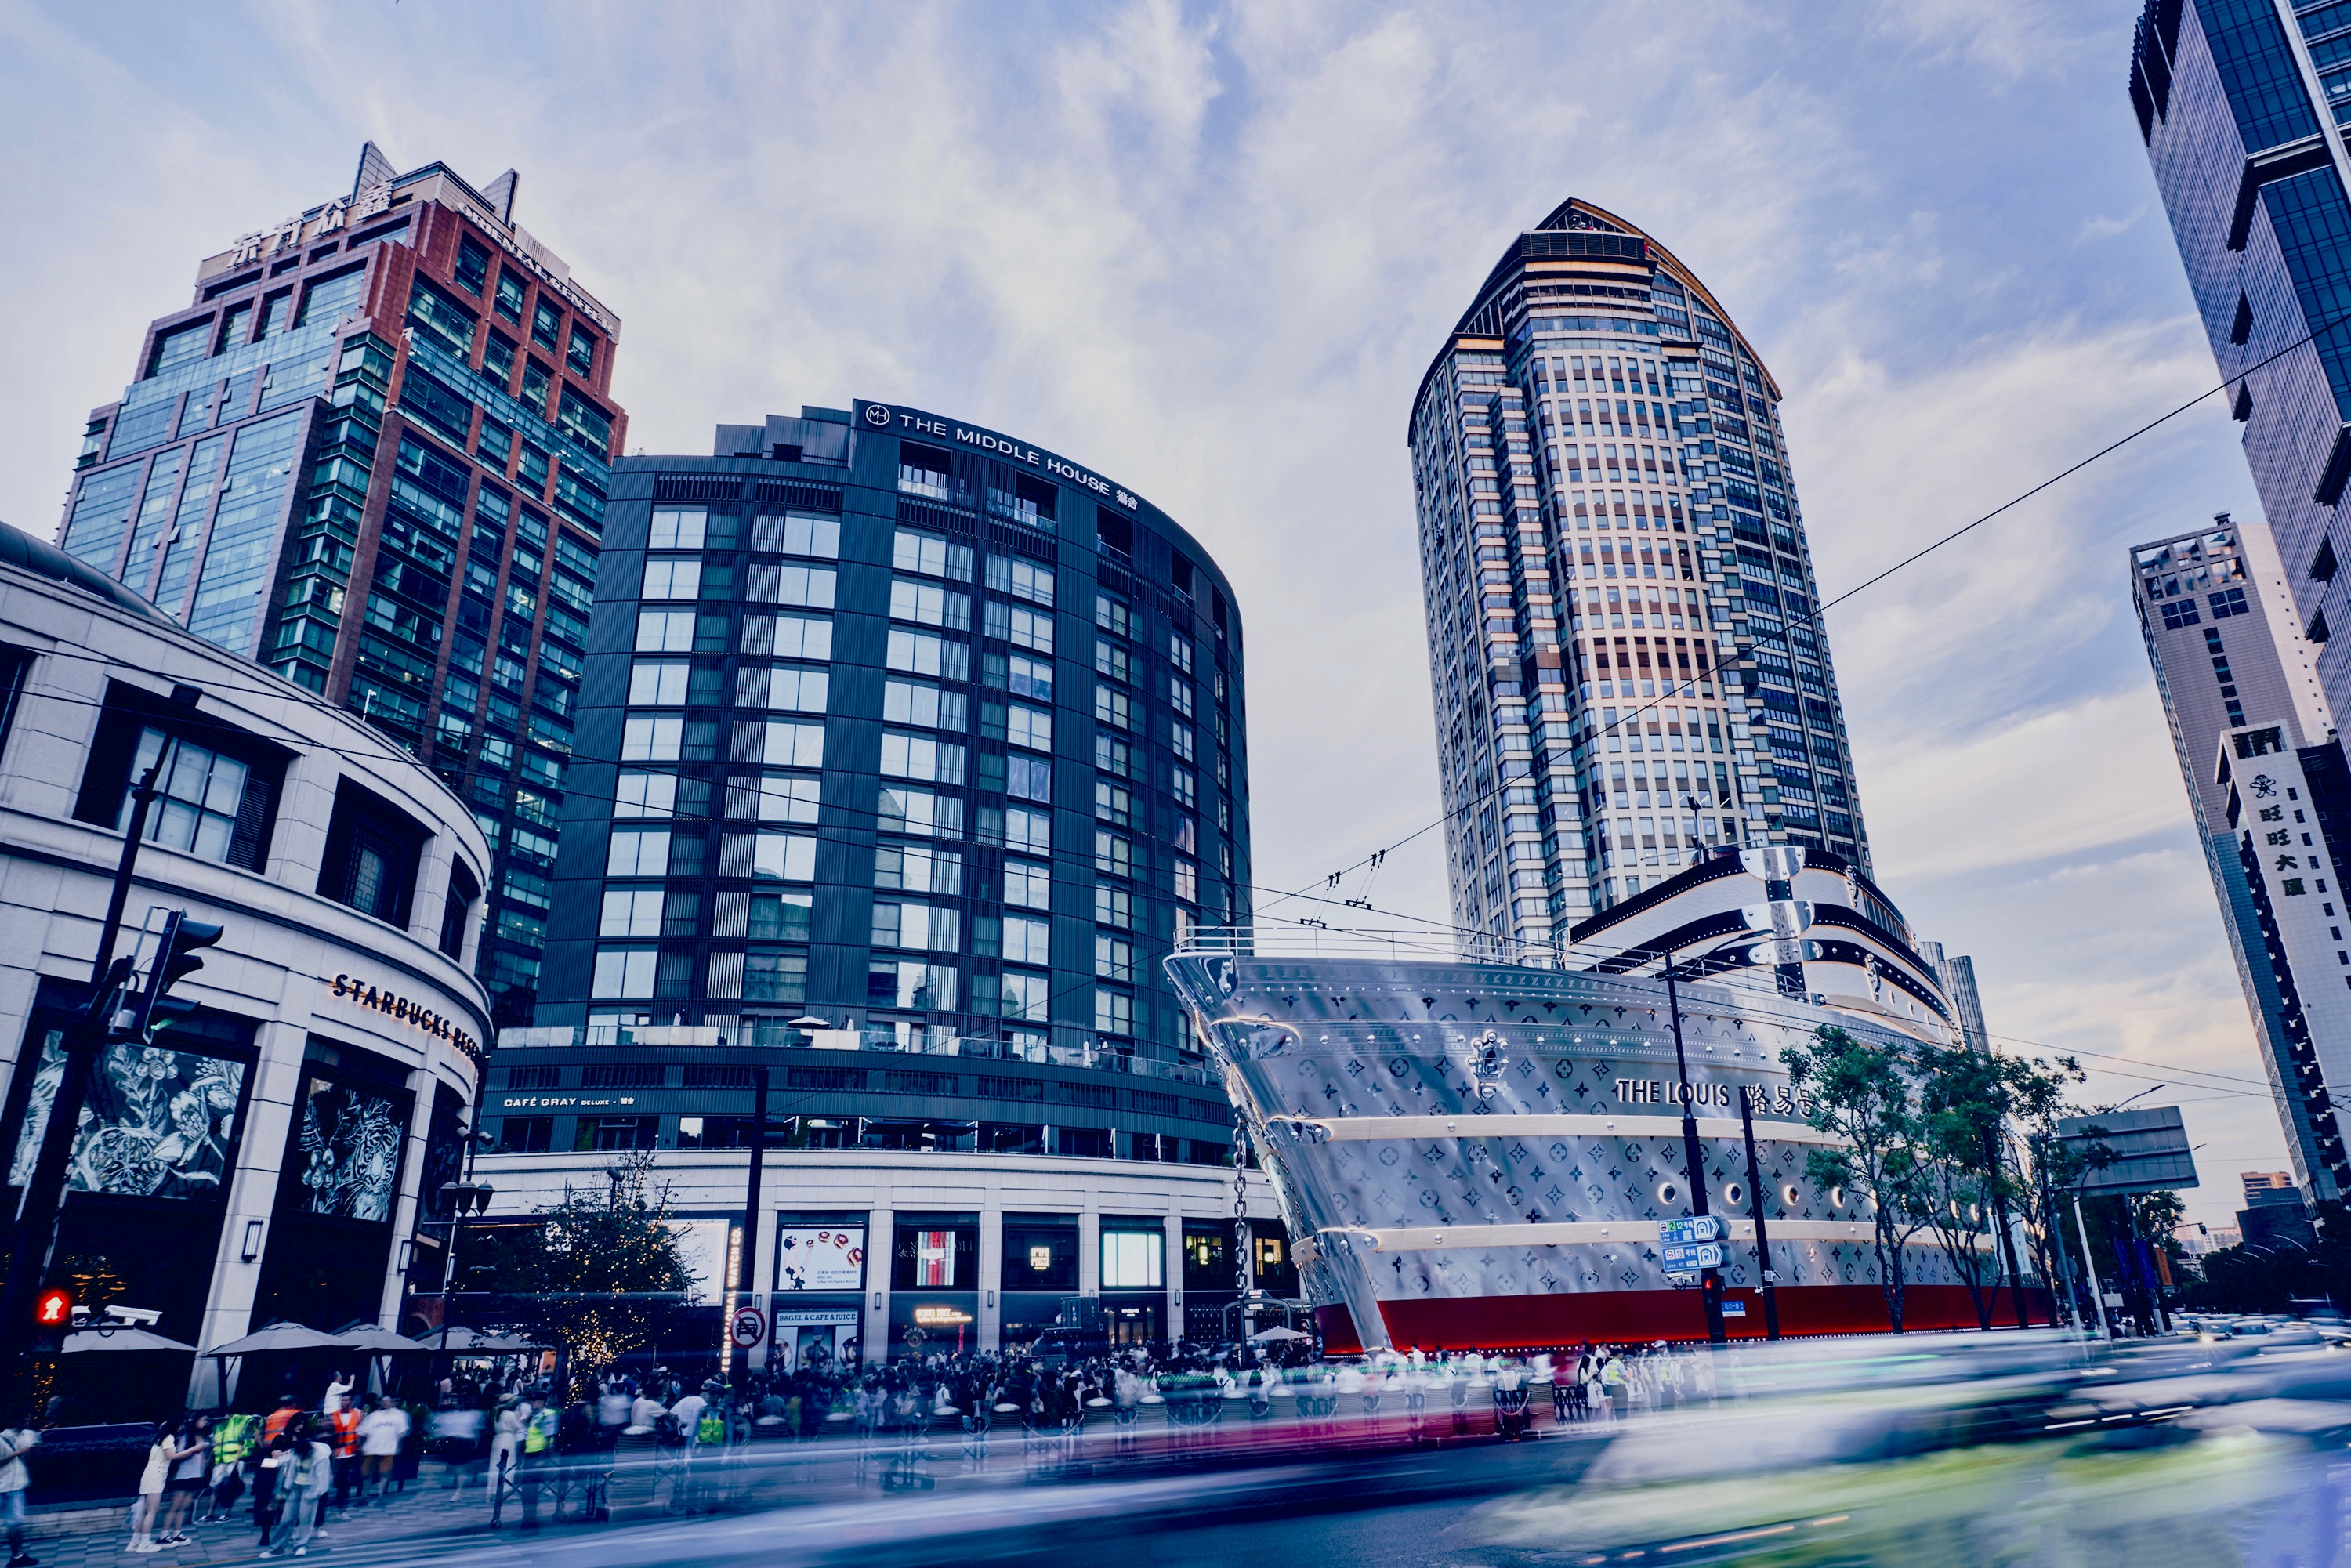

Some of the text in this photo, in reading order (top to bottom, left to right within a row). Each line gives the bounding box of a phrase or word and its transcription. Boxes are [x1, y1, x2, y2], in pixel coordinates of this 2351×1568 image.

[226, 181, 393, 268] 东方众鑫
[457, 202, 614, 336] ORIENTAL CENTER
[900, 415, 947, 436] THE
[956, 428, 1040, 465] MIDDLE
[1047, 458, 1110, 496] HOUSE
[333, 974, 450, 1040] STARBUCKS
[504, 1097, 537, 1107] CAFÉ
[541, 1098, 577, 1106] GRAY
[1616, 1078, 1815, 1119] THE LOUIS 路易号
[1669, 1222, 1675, 1231] 2
[721, 1227, 741, 1372] TERNATIONAL WATCH CO.
